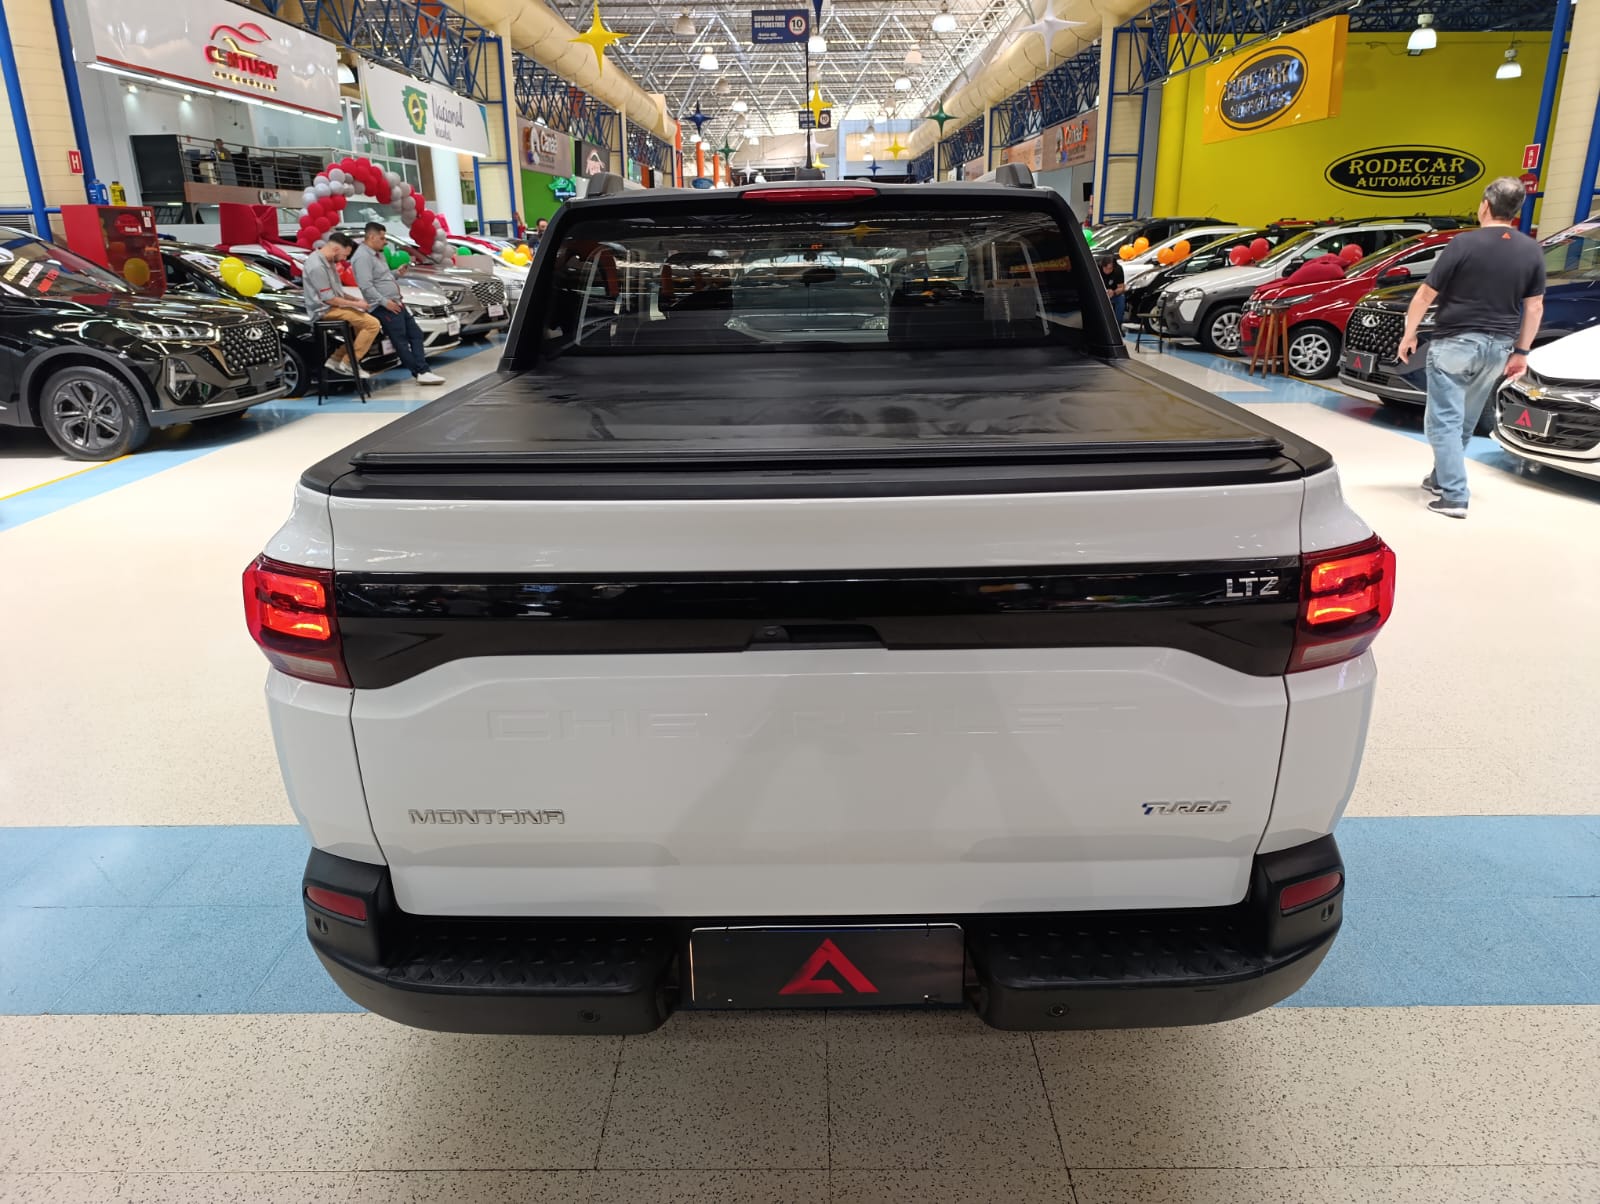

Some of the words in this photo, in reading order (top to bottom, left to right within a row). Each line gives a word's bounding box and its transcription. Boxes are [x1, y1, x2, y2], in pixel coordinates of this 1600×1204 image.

[791, 19, 803, 28] 10
[204, 45, 278, 79] CENTURY
[71, 154, 81, 170] H
[1349, 158, 1465, 175] RODECAR
[1356, 173, 1456, 187] AUTOMÓVEIS
[1226, 576, 1279, 598] LTZ
[487, 704, 1142, 741] CHEVROLET
[1141, 800, 1232, 815] TURBO
[408, 809, 565, 824] MONTANA
